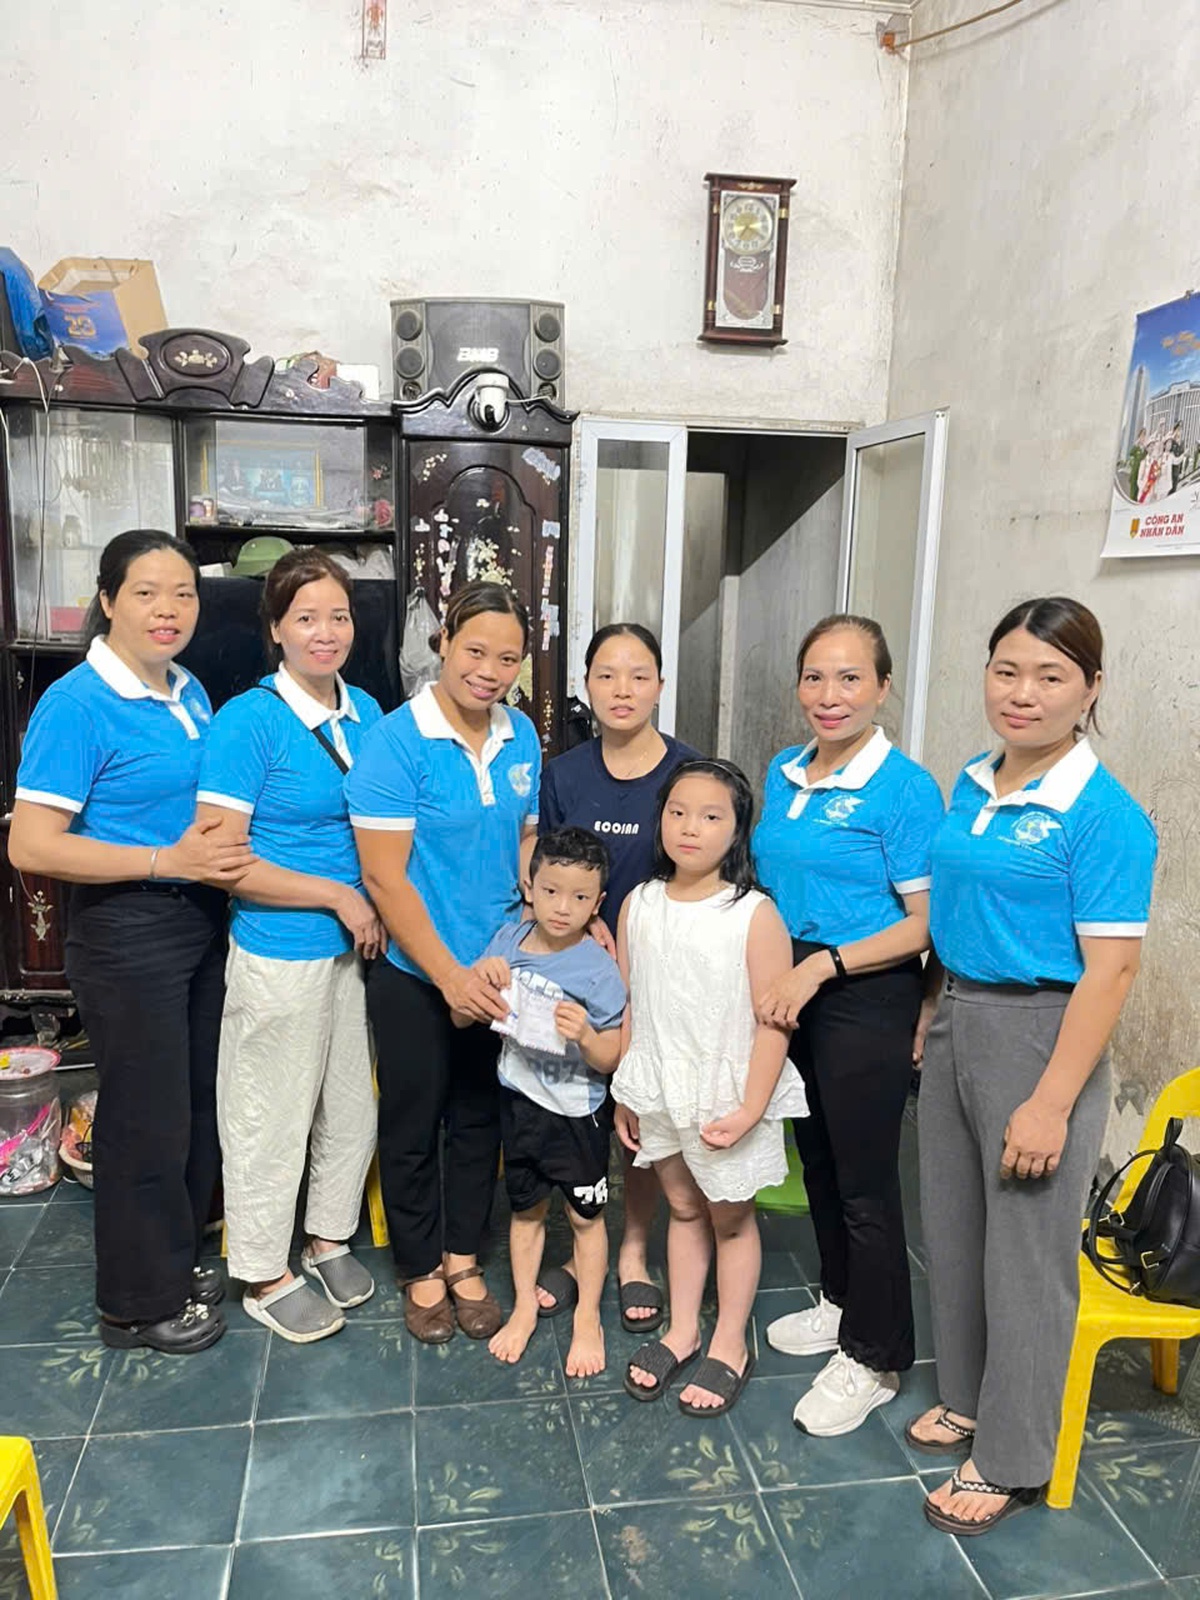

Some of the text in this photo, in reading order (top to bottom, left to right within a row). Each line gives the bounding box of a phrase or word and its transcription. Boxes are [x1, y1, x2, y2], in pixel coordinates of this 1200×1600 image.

[1145, 513, 1184, 526] CÔNG AN
[1140, 524, 1185, 538] NHÂN DÂN
